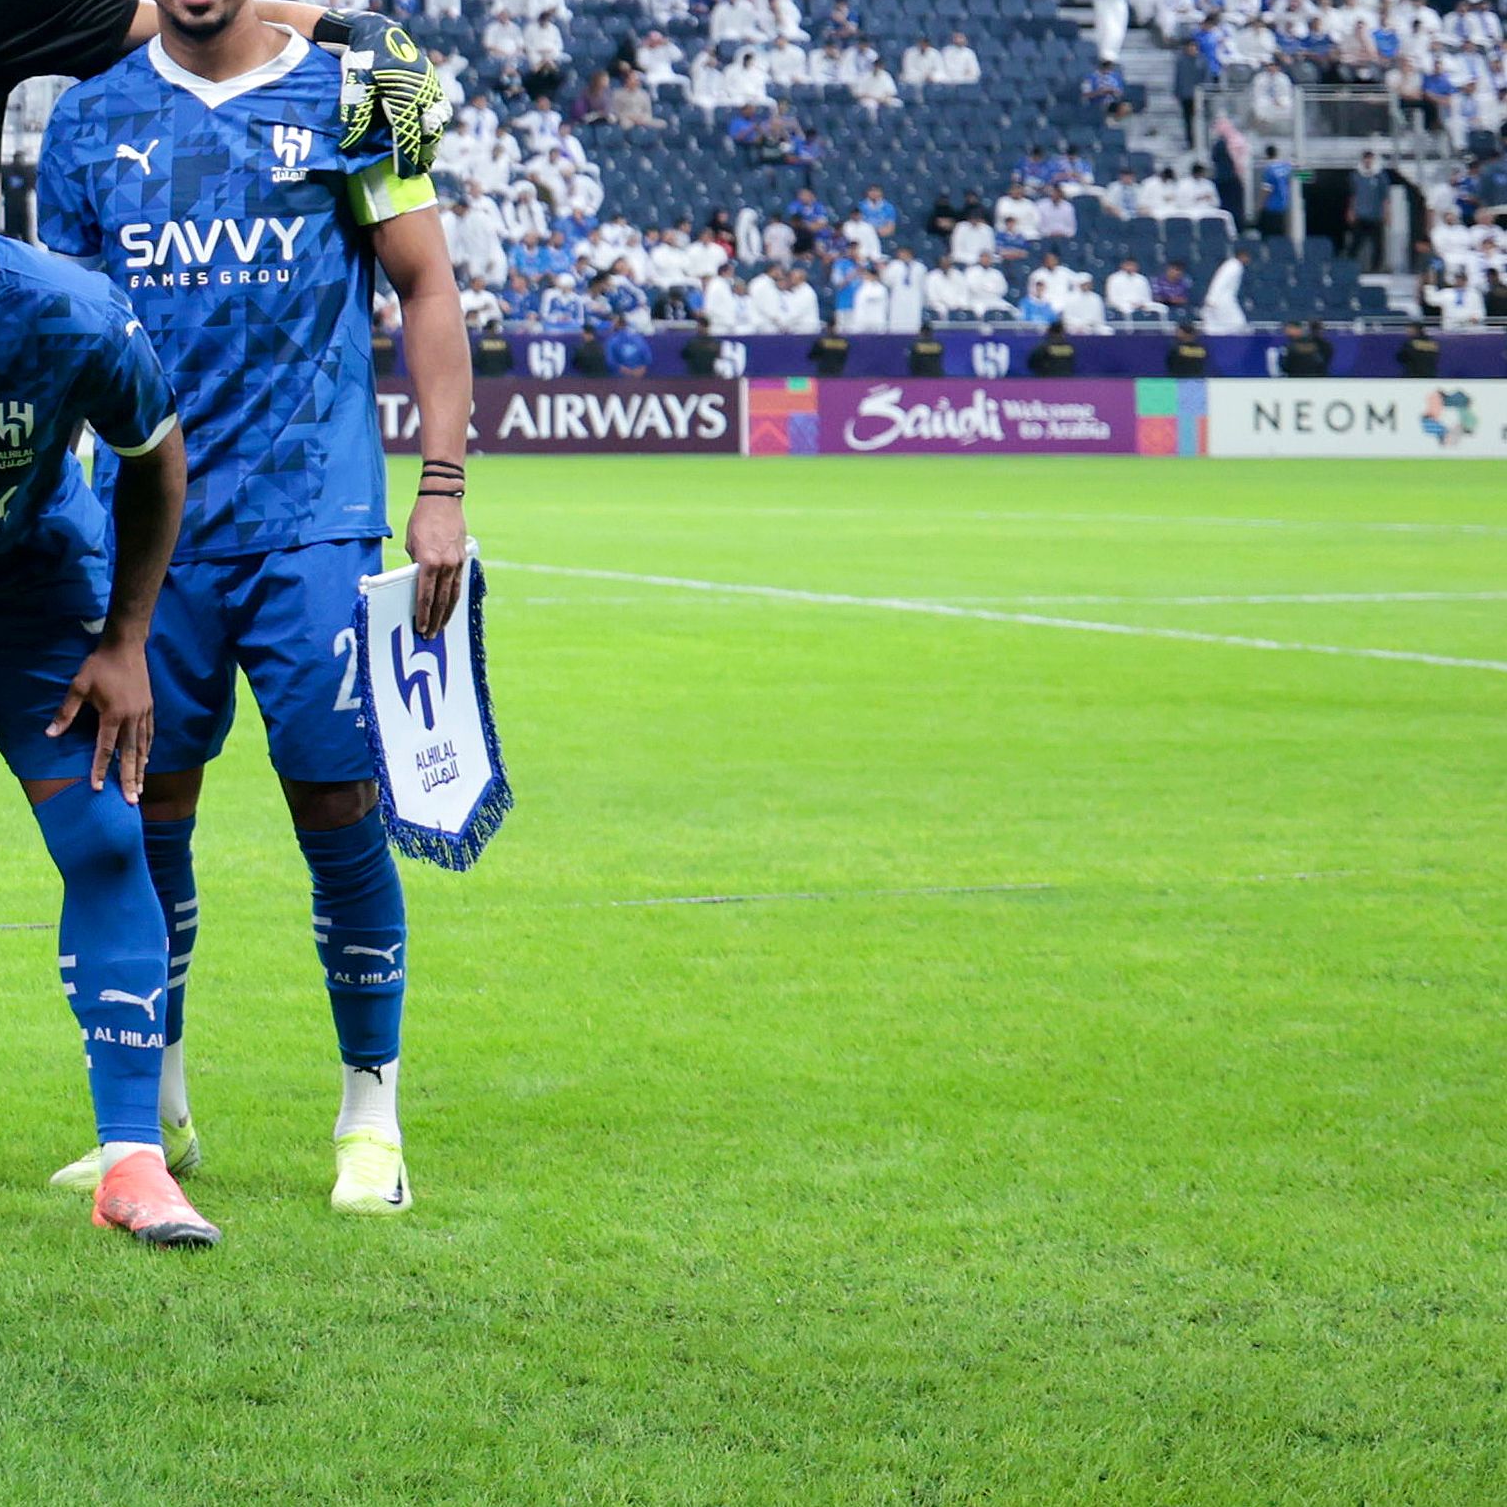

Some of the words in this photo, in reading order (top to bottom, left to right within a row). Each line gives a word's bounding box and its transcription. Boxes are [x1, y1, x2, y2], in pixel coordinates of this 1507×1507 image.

[120, 216, 305, 268] SAVVY
[130, 272, 209, 288] GAMES
[220, 268, 299, 284] GROU
[496, 392, 727, 440] AIRWAYS
[843, 383, 1005, 451] Saudi
[1252, 399, 1398, 434] NEOM
[415, 740, 458, 771] ALHILAL
[422, 760, 460, 793] الهلال
[333, 971, 355, 984] AL
[93, 1026, 116, 1043] AL
[120, 1030, 165, 1048] HILAL
